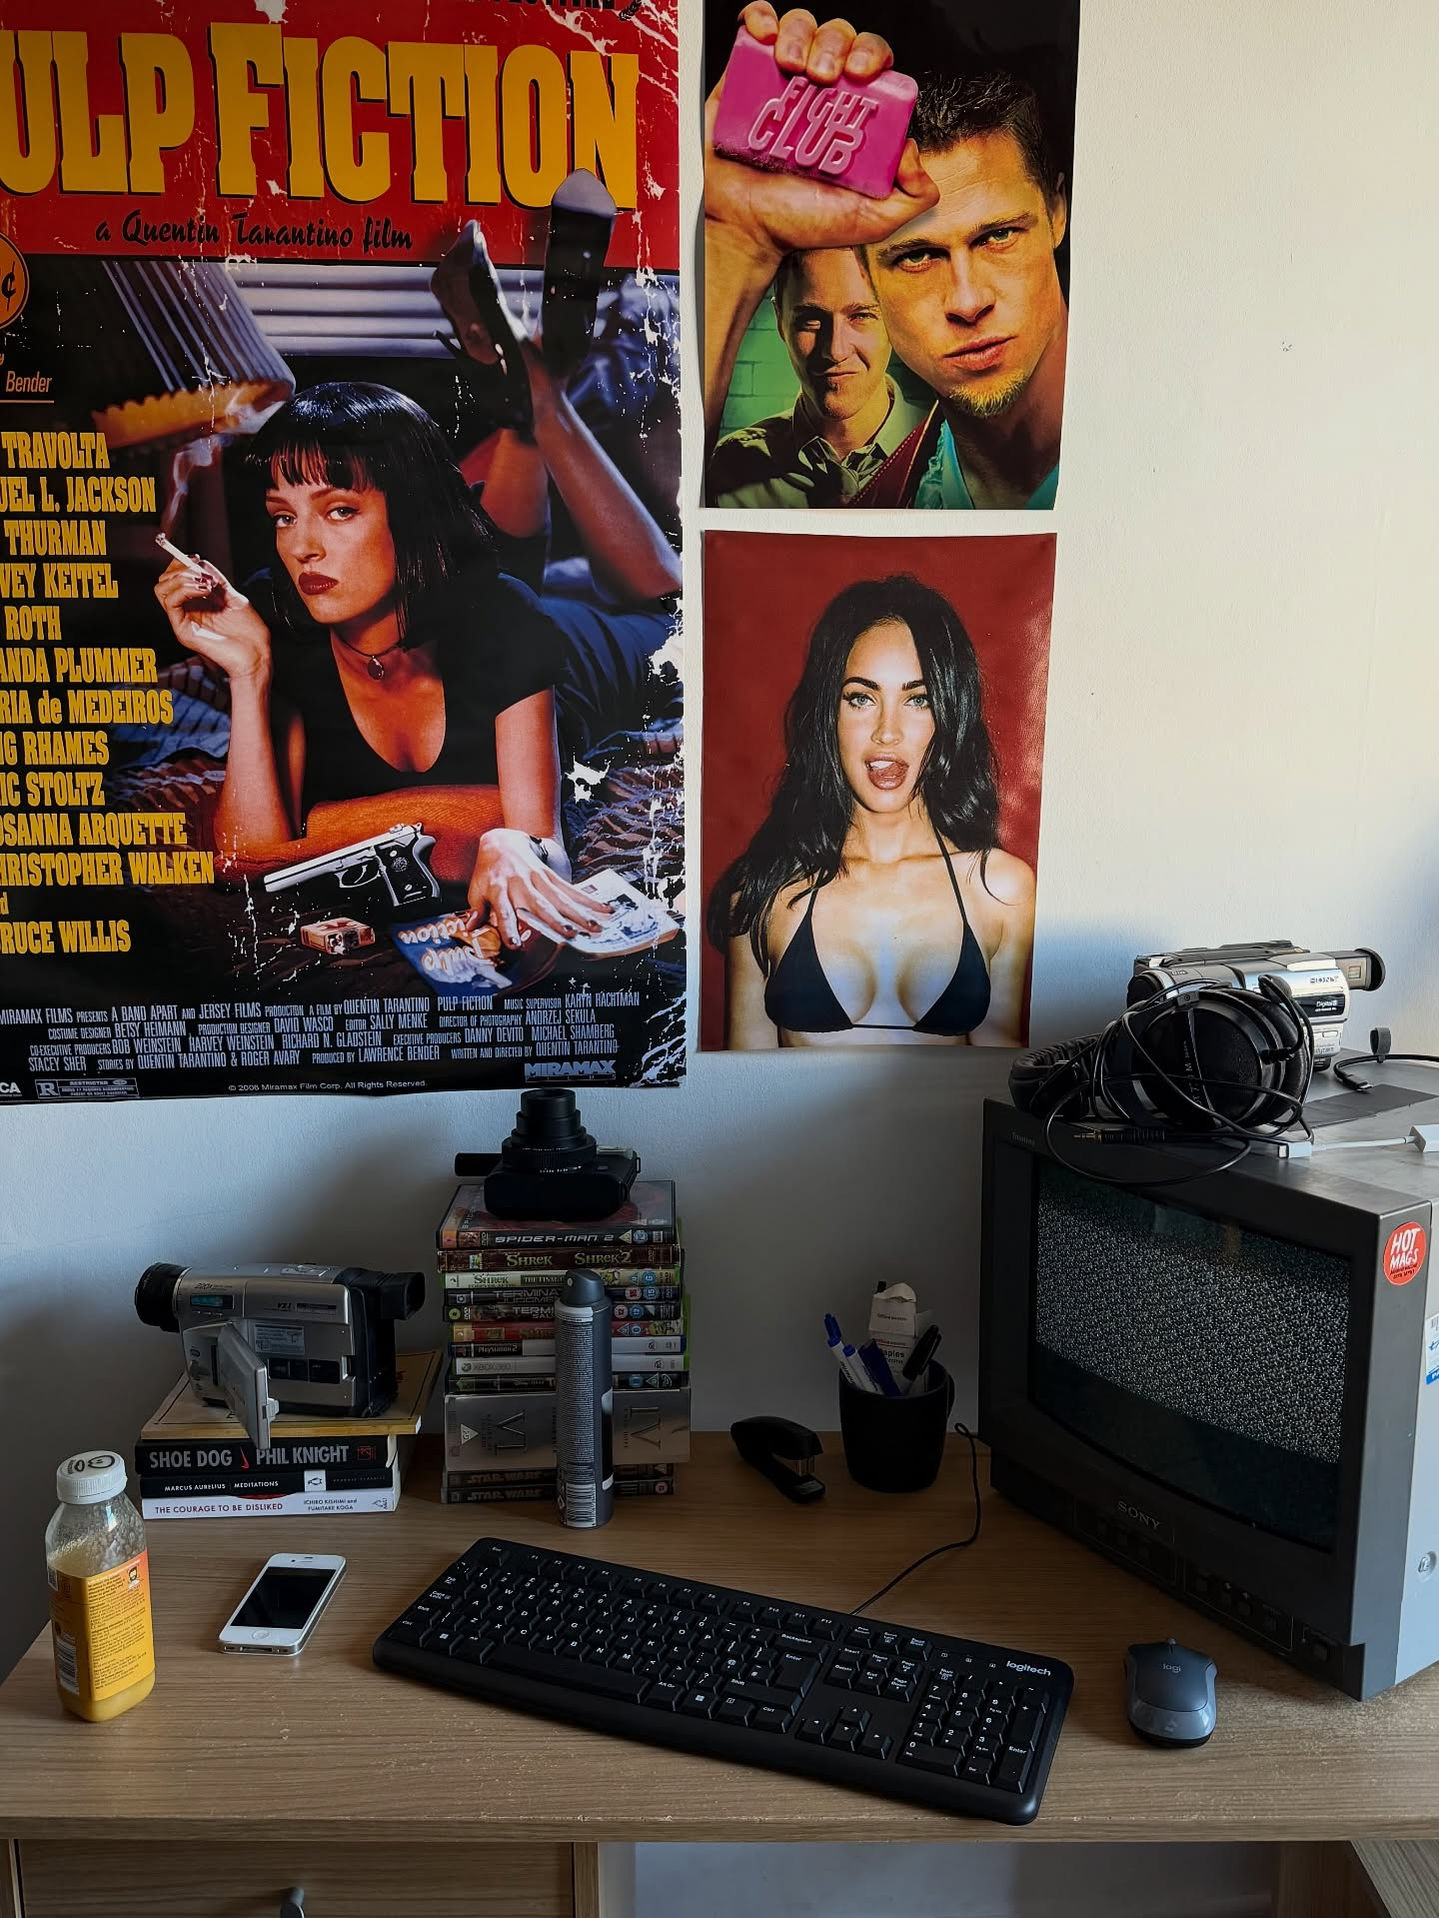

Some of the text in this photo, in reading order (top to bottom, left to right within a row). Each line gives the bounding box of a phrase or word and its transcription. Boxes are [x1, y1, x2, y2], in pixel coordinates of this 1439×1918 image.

[0, 22, 639, 210] ULP FICTION
[780, 75, 879, 131] FIGHT
[748, 97, 864, 175] CLUB
[95, 210, 413, 252] a Quentin Tarantino film
[6, 371, 52, 393] Bender
[1, 432, 110, 469] TRAVOLTA
[40, 477, 60, 513] L.
[66, 476, 156, 513] JACKSON
[4, 520, 107, 556] THURMAN
[43, 563, 119, 598] KEITEL
[4, 605, 62, 641] ROTH
[54, 647, 158, 683] PLUMMER
[38, 689, 62, 724] de
[67, 690, 173, 724] MEDEIROS
[23, 730, 109, 765] RHAMES
[26, 771, 105, 807] STOLTZ
[0, 812, 187, 849] SANNA ARQUETTE
[128, 851, 215, 885] WALKEN
[58, 919, 131, 953] WILLIS
[0, 1008, 42, 1025] MIRAMAX
[46, 1008, 73, 1024] FILMS
[76, 1010, 108, 1023] PRESENTS
[112, 1006, 118, 1021] A
[122, 1005, 146, 1021] BAND
[151, 1005, 177, 1020] APART
[199, 1003, 230, 1019] JERSEY
[235, 1002, 261, 1018] FILMS
[265, 1005, 304, 1017] PRODUCTION
[344, 998, 379, 1014] QUENTIN
[383, 997, 429, 1012] TARANTINO
[437, 996, 458, 1011] PULP
[462, 996, 493, 1010] FICTION
[504, 999, 523, 1009] MUSIC
[526, 998, 562, 1009] SUPERVISOR
[596, 992, 639, 1007] RACHTMAN
[48, 1008, 596, 1040] COSTUME DESIGNER BETSY HEIMANN PRODUCTION DESIGNER DAVID WASCO EDITOR SALLY MENKE DIRECTOR OF PHOTOGRAPHY ANDRZEJ SEKULA
[28, 1056, 60, 1072] STACEY
[63, 1055, 87, 1071] SHER
[97, 1058, 123, 1070] STORIES
[137, 1054, 175, 1069] QUENTIN
[177, 1053, 227, 1068] TARANTINO
[230, 1053, 238, 1067] &
[241, 1051, 270, 1066] ROGER
[273, 1050, 300, 1065] AVARY
[311, 1052, 345, 1064] PRODUCED
[358, 1047, 404, 1062] LAWRENCE
[407, 1046, 439, 1060] BENDER
[451, 1048, 478, 1060] WRITTEN
[479, 1047, 493, 1059] AND
[494, 1046, 523, 1058] DIRECTED
[535, 1041, 570, 1057] QUENTIN
[574, 1039, 618, 1055] TARANTINO
[30, 1024, 615, 1057] CO-EXECUTIVE PRODUCERS BOB WEINSTEIN HARVEY WEINSTEIN RICHARD N. GLADSTEIN EXECUTIVE PRODUCERS DANNY DEVITO MICHAEL SHAMBERG
[524, 1060, 616, 1077] MIRAMAX
[38, 1082, 59, 1096] R
[357, 1081, 384, 1090] Rights
[495, 1234, 615, 1243] SPIDER-MAN 2
[1391, 1228, 1421, 1255] HOT
[505, 1252, 553, 1266] SHREK
[1390, 1248, 1419, 1269] MAGS
[493, 1288, 560, 1298] TERMINA
[150, 1446, 349, 1469] SHOE DOG PHIL KNIGHT
[164, 1480, 279, 1492] MARCUS AURELIUS MEDITATIONS
[154, 1506, 171, 1514] THE
[173, 1505, 215, 1513] COURAGE
[232, 1504, 244, 1512] BE
[245, 1503, 283, 1511] DISLIKED
[1118, 1500, 1160, 1529] SONY
[1006, 1660, 1051, 1677] logitech
[1162, 1663, 1182, 1674] logi
